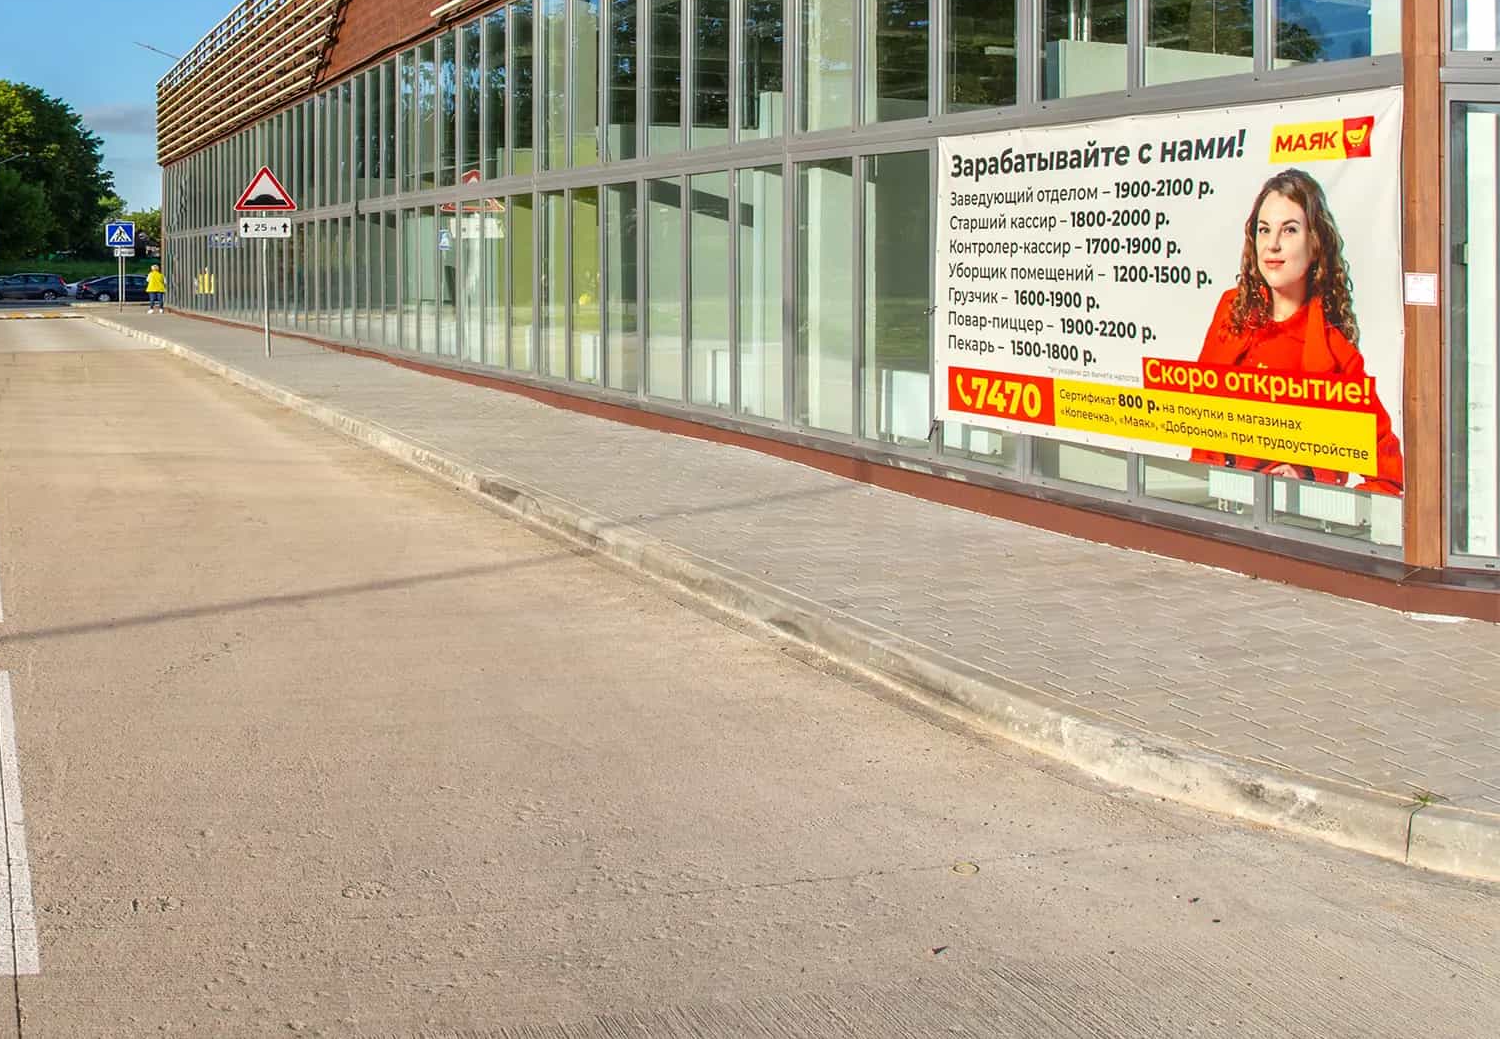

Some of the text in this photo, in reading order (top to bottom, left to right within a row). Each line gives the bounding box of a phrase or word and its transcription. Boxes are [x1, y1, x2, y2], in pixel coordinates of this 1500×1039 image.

[951, 129, 1246, 181] Зарабатывайте с нами!
[1276, 131, 1338, 152] МАЯК
[950, 187, 1034, 209] Заведующий
[1036, 185, 1098, 204] отделом
[1114, 178, 1193, 199] 1900-2100
[1198, 180, 1214, 199] р.
[254, 224, 268, 232] 25
[949, 215, 1007, 232] Старший
[1010, 217, 1057, 233] кассир
[1070, 210, 1150, 228] 1800-2000
[1155, 212, 1170, 230] р.
[949, 240, 1071, 258] Контролер-кассир
[1085, 237, 1162, 255] 1700-1900
[1166, 239, 1182, 259] р.
[948, 263, 1007, 282] Уборщик
[1010, 264, 1094, 282] помещений
[1113, 265, 1191, 285] 1200-1500
[1196, 268, 1213, 289] р.
[948, 287, 998, 306] Грузчик
[1014, 289, 1082, 309] 1600-1900
[1086, 294, 1100, 313] р.
[948, 311, 1043, 335] Повар-пиццер
[1060, 317, 1137, 339] 1900-2200
[1141, 323, 1157, 344] р.
[948, 334, 995, 356] Пекарь
[1010, 340, 1079, 362] 1500-1800
[1082, 349, 1097, 367] р.
[971, 376, 1042, 419] 7470
[1145, 359, 1218, 393] Скоро
[1224, 372, 1372, 405] открытие!
[1059, 388, 1303, 431] Сертификат 800 р. на покупки в магазинах
[1160, 420, 1228, 440] «Доброном»
[1231, 430, 1254, 445] при
[1256, 435, 1369, 461] трудоустройстве
